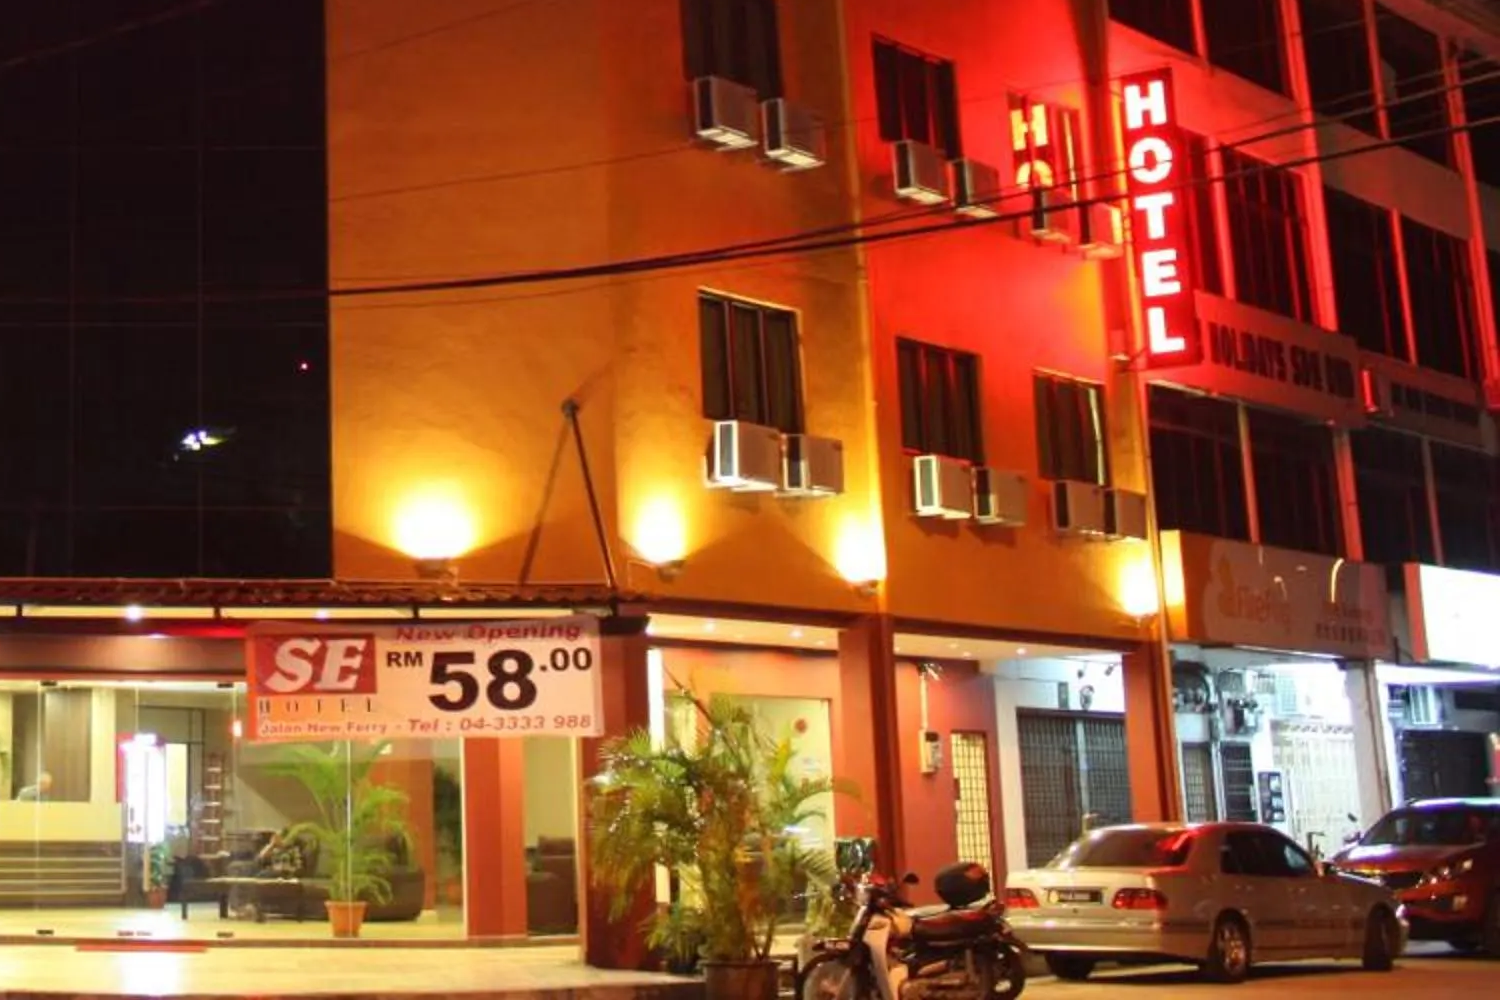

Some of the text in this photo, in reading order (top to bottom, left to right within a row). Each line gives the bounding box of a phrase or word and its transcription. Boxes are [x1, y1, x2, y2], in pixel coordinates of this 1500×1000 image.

[1123, 79, 1186, 355] HOTEL
[395, 623, 581, 642] New Opening
[264, 638, 367, 689] SE
[386, 651, 424, 667] RM
[261, 723, 302, 735] Jalan
[308, 721, 341, 733] New
[460, 716, 545, 730] 04-3333
[554, 715, 591, 729] 988
